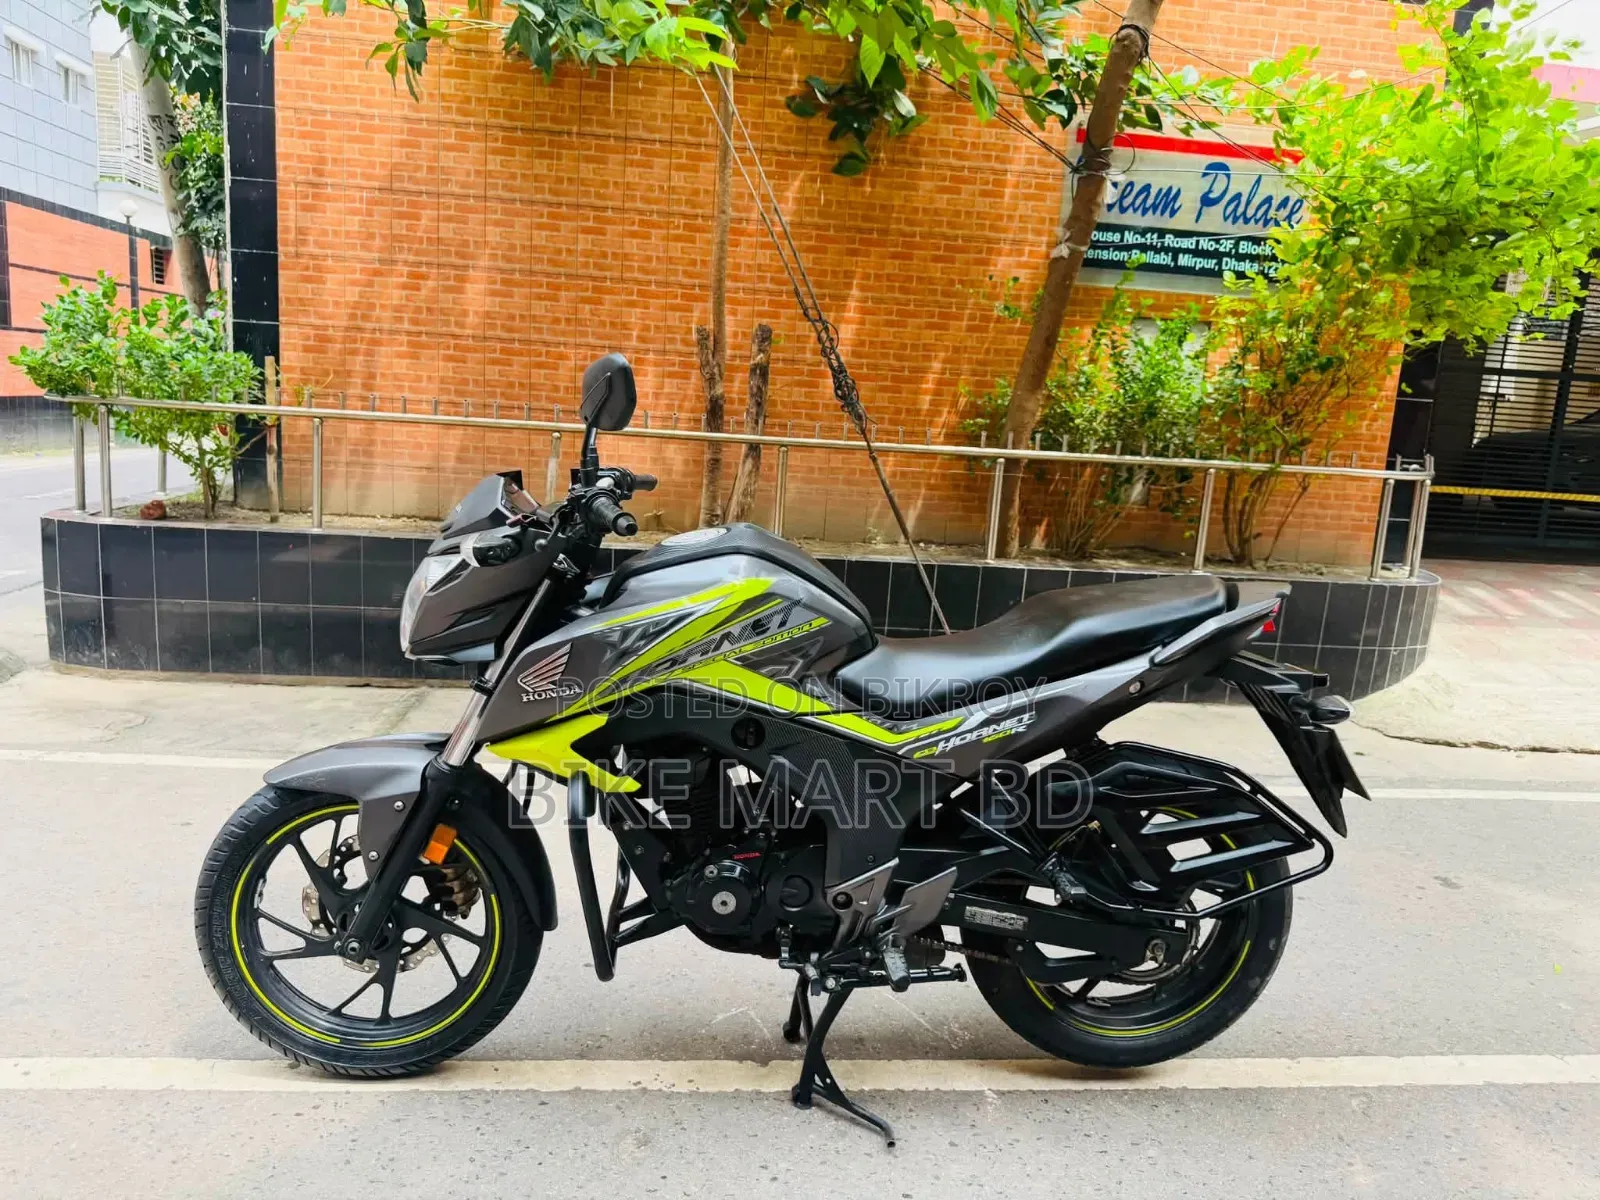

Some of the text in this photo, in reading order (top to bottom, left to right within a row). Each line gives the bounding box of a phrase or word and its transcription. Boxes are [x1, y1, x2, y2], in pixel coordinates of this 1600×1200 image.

[1195, 161, 1304, 230] Palace
[1090, 230, 1276, 256] ouse No-11, Road No-2F, Block-
[1084, 247, 1128, 261] ension
[1177, 253, 1219, 270] Mirpur,
[521, 684, 584, 702] HONDA
[934, 711, 1036, 756] HORNET
